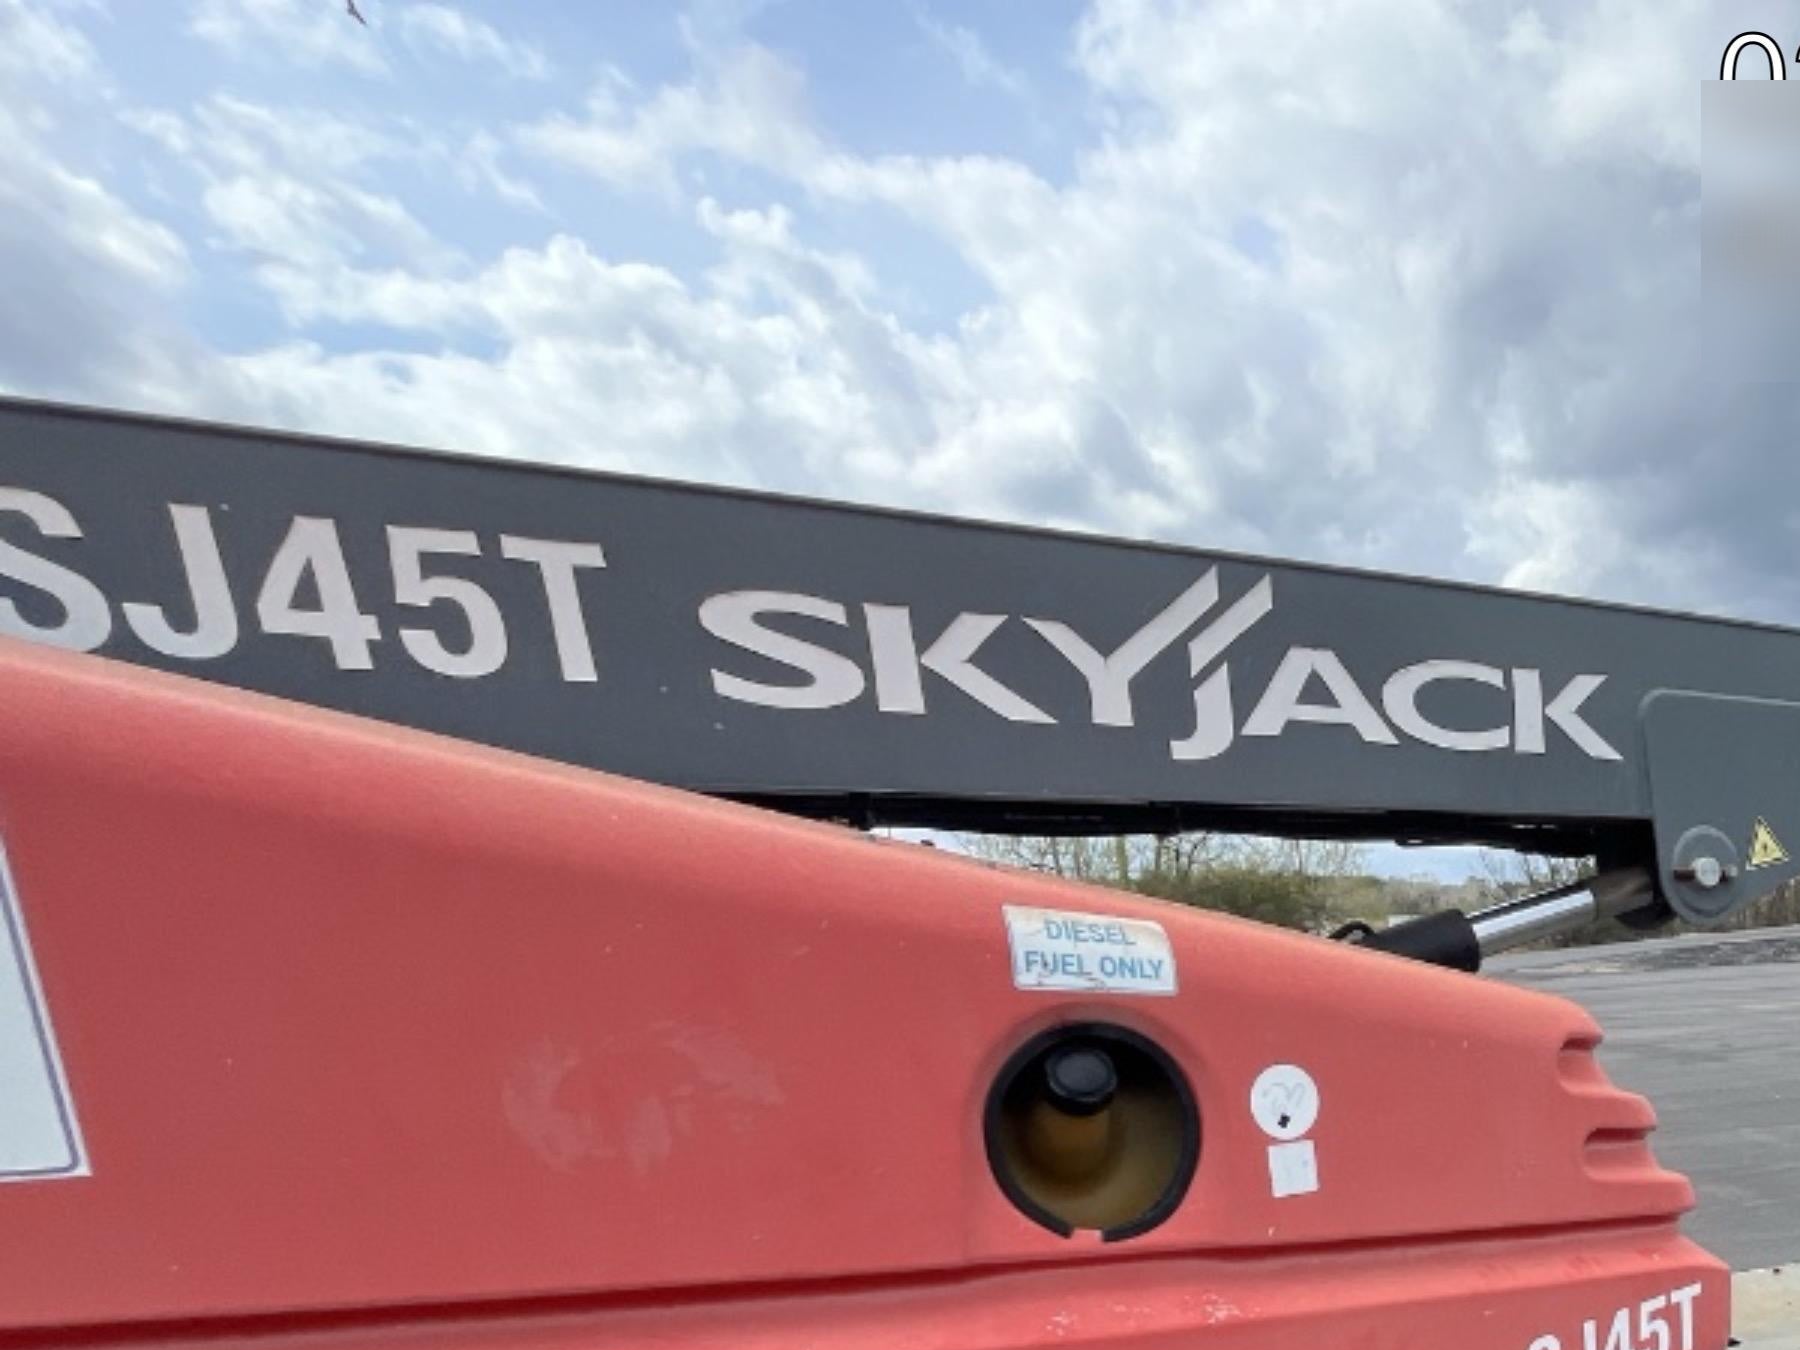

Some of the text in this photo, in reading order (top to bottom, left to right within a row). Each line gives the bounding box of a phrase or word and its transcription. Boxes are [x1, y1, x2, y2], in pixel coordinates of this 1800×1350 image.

[0, 485, 607, 683] SJ45T
[697, 563, 1624, 762] SKYJACK
[1024, 950, 1164, 980] FUEL ONLY
[1043, 918, 1137, 946] DIESEL
